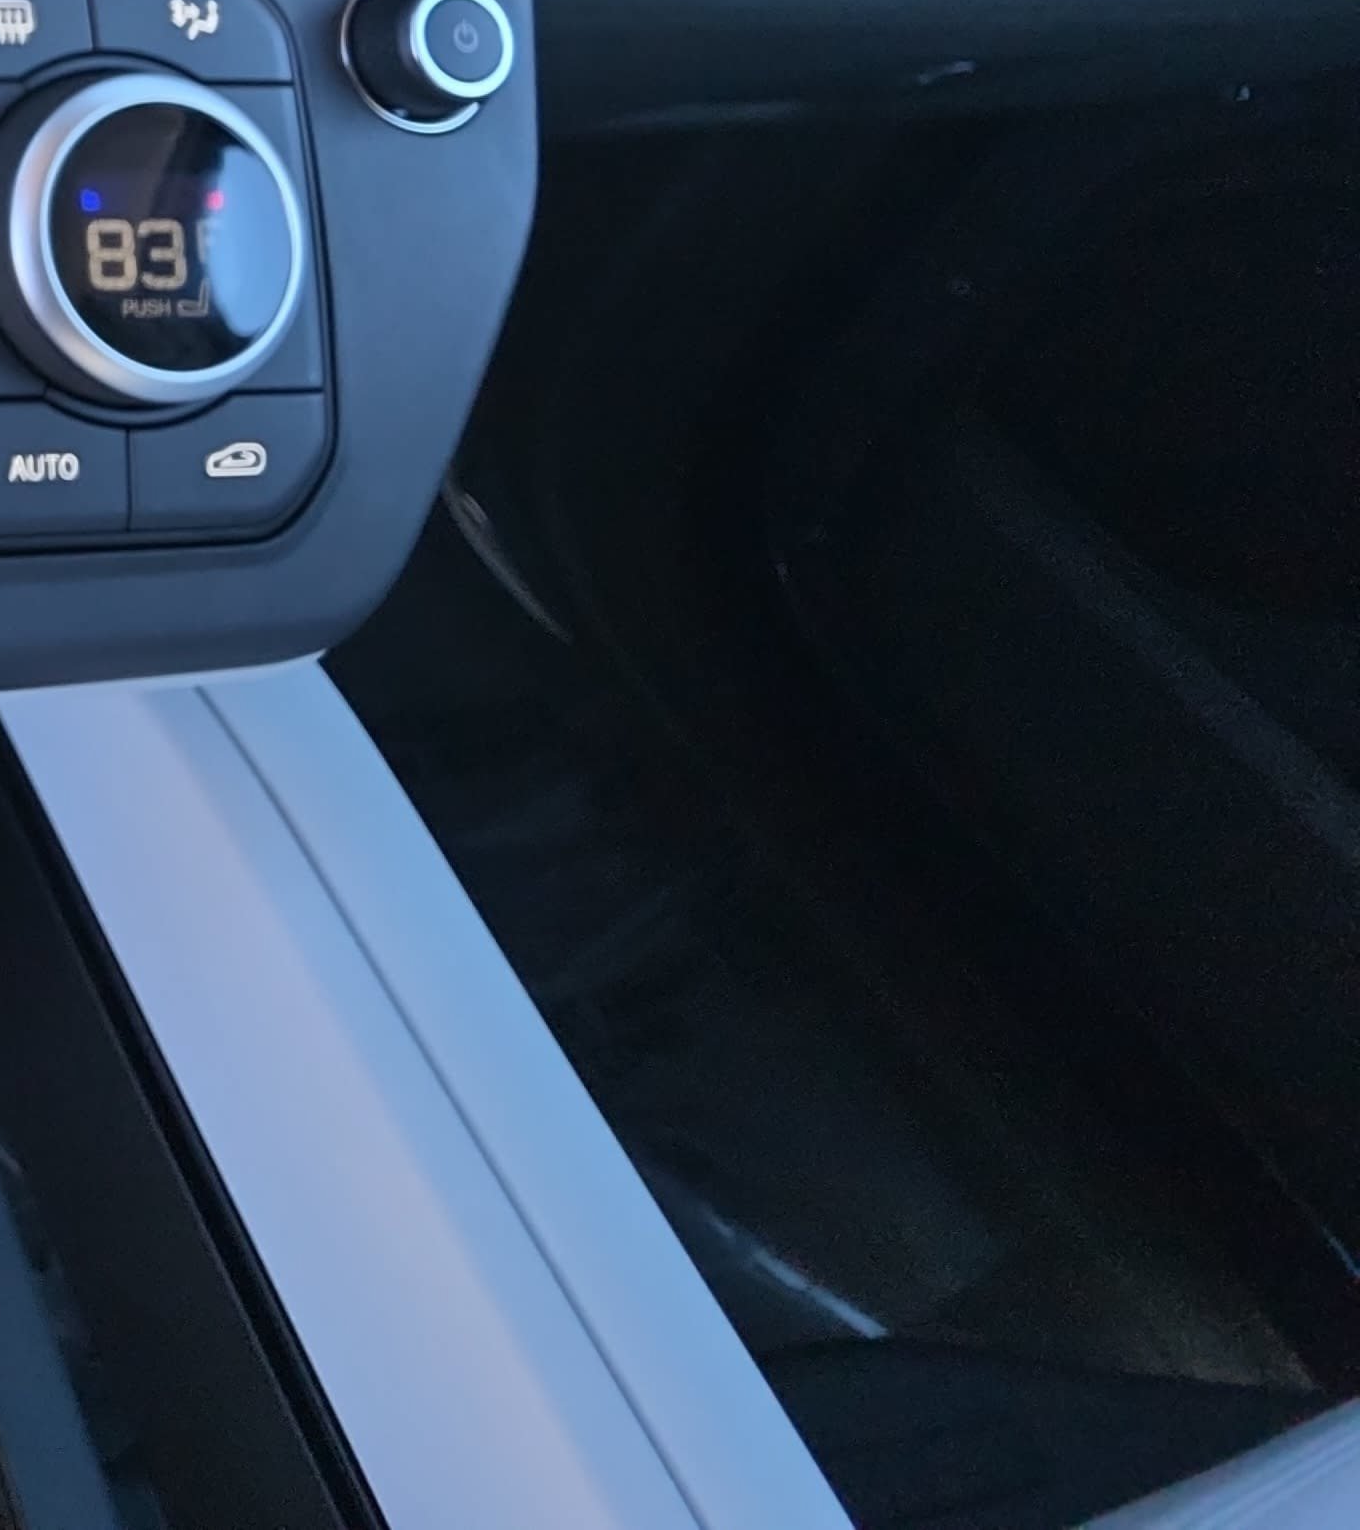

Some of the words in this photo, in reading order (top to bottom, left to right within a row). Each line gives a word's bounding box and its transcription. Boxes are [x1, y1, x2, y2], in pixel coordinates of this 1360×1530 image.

[86, 217, 188, 292] 83
[121, 297, 173, 319] PUSH
[7, 452, 80, 484] AUTO
